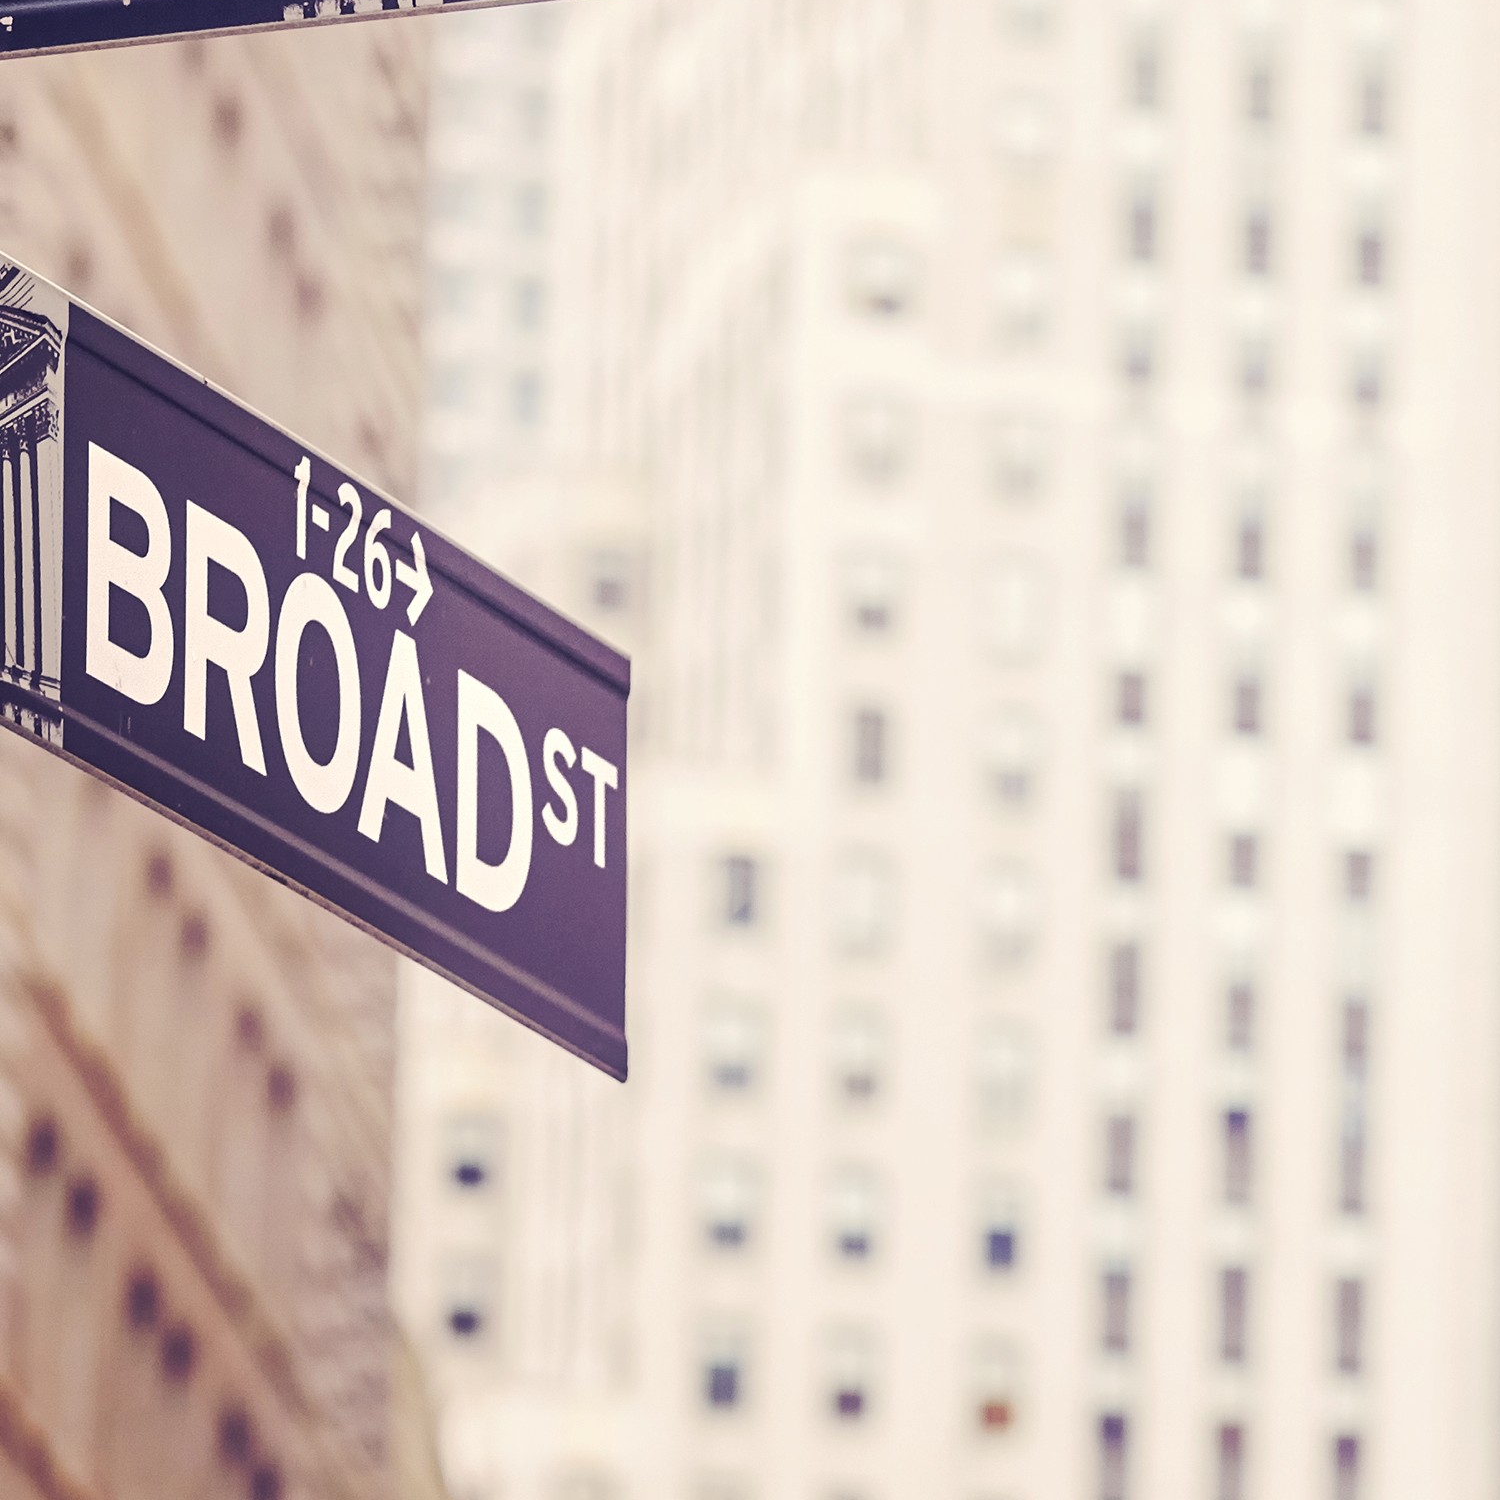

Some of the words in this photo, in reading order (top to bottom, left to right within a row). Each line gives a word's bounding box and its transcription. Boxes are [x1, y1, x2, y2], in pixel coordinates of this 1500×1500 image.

[85, 440, 535, 913] BROAD
[541, 727, 619, 869] ST
[294, 455, 391, 610] 1-26
